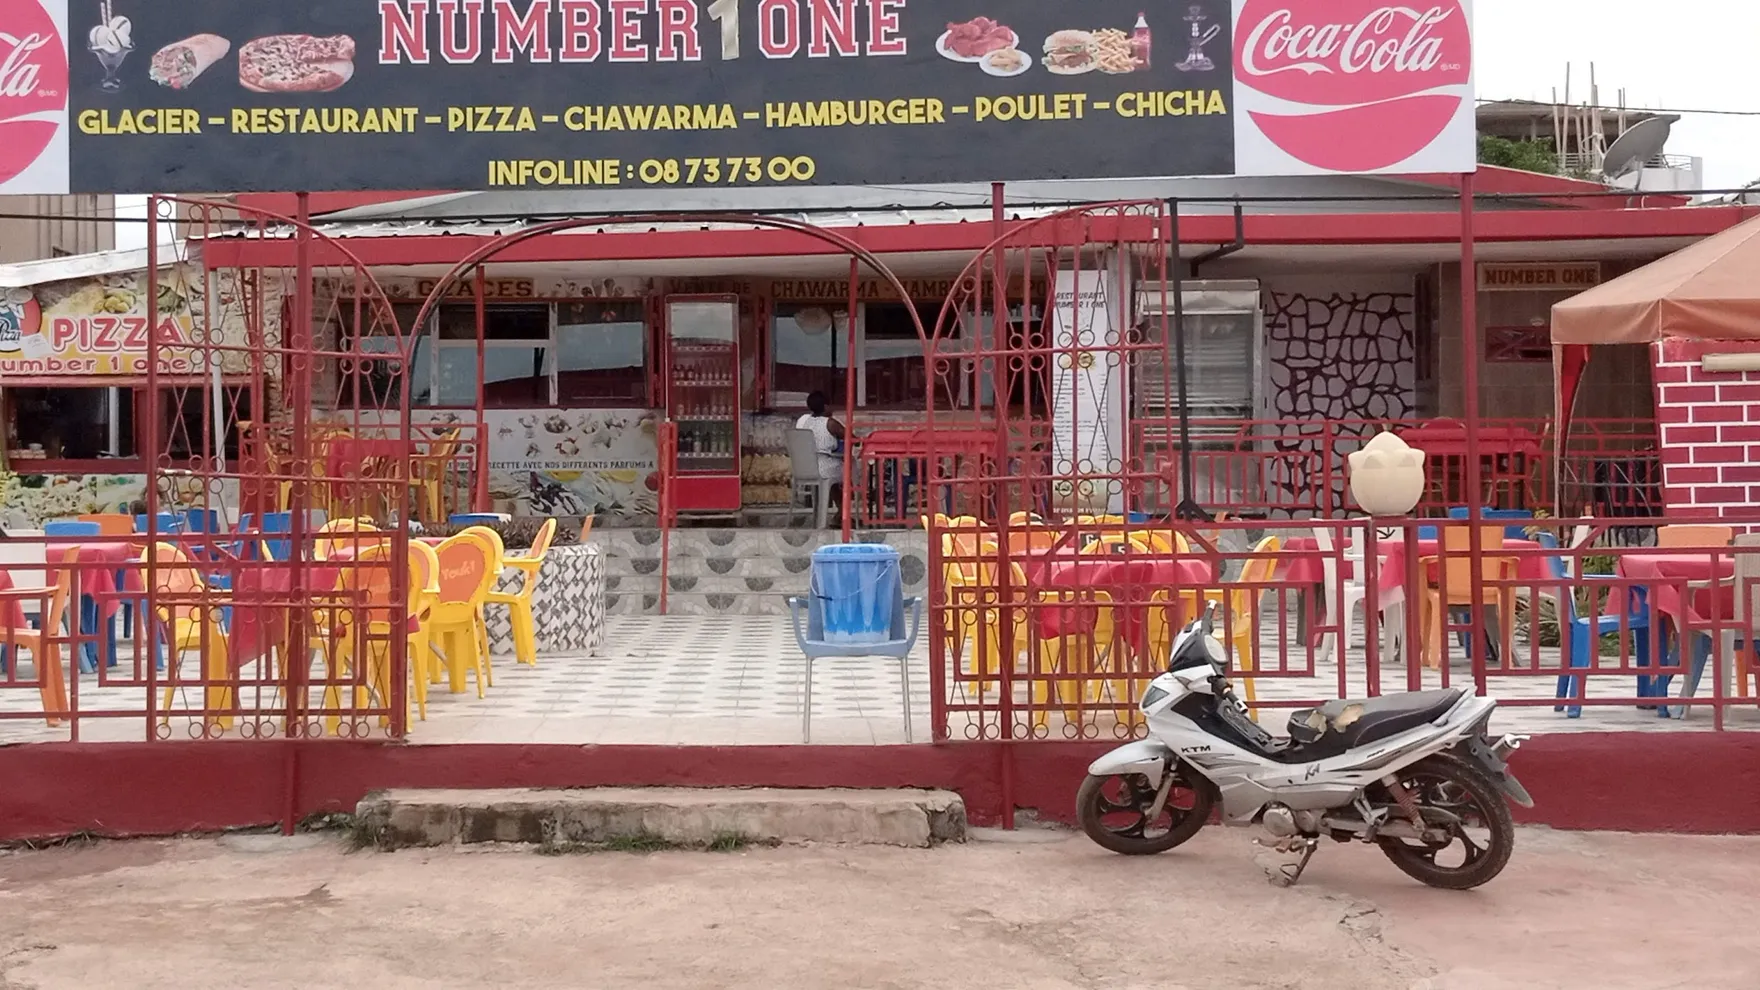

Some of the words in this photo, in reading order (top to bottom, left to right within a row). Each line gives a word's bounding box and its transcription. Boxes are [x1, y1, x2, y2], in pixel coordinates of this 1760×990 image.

[379, 0, 701, 63] NUMBER
[707, 0, 740, 60] 1
[758, 0, 907, 59] ONE
[1242, 6, 1456, 76] Coca-Cola
[78, 109, 201, 134] GLACIER
[231, 107, 419, 133] RESTAURANT
[448, 106, 536, 132] PIZZA
[564, 103, 738, 131] CHAWARMA
[765, 98, 945, 128] HAMBURGER
[975, 93, 1088, 122] POULET
[1115, 89, 1227, 118] CHICHA
[488, 159, 621, 185] INFOLINE
[639, 159, 680, 184] 08
[685, 158, 721, 184] 73
[726, 157, 763, 183] 73
[767, 155, 816, 181] 00
[1484, 268, 1557, 285] NUMBER
[1562, 267, 1597, 284] ONE
[418, 280, 533, 297] GACES
[771, 280, 879, 298] CHAWARMA
[1056, 292, 1104, 300] RESTURANT
[53, 317, 185, 349] PIZZA
[111, 356, 118, 371] 1
[133, 357, 188, 371] one
[523, 461, 543, 469] AVEC
[545, 461, 560, 469] NOS
